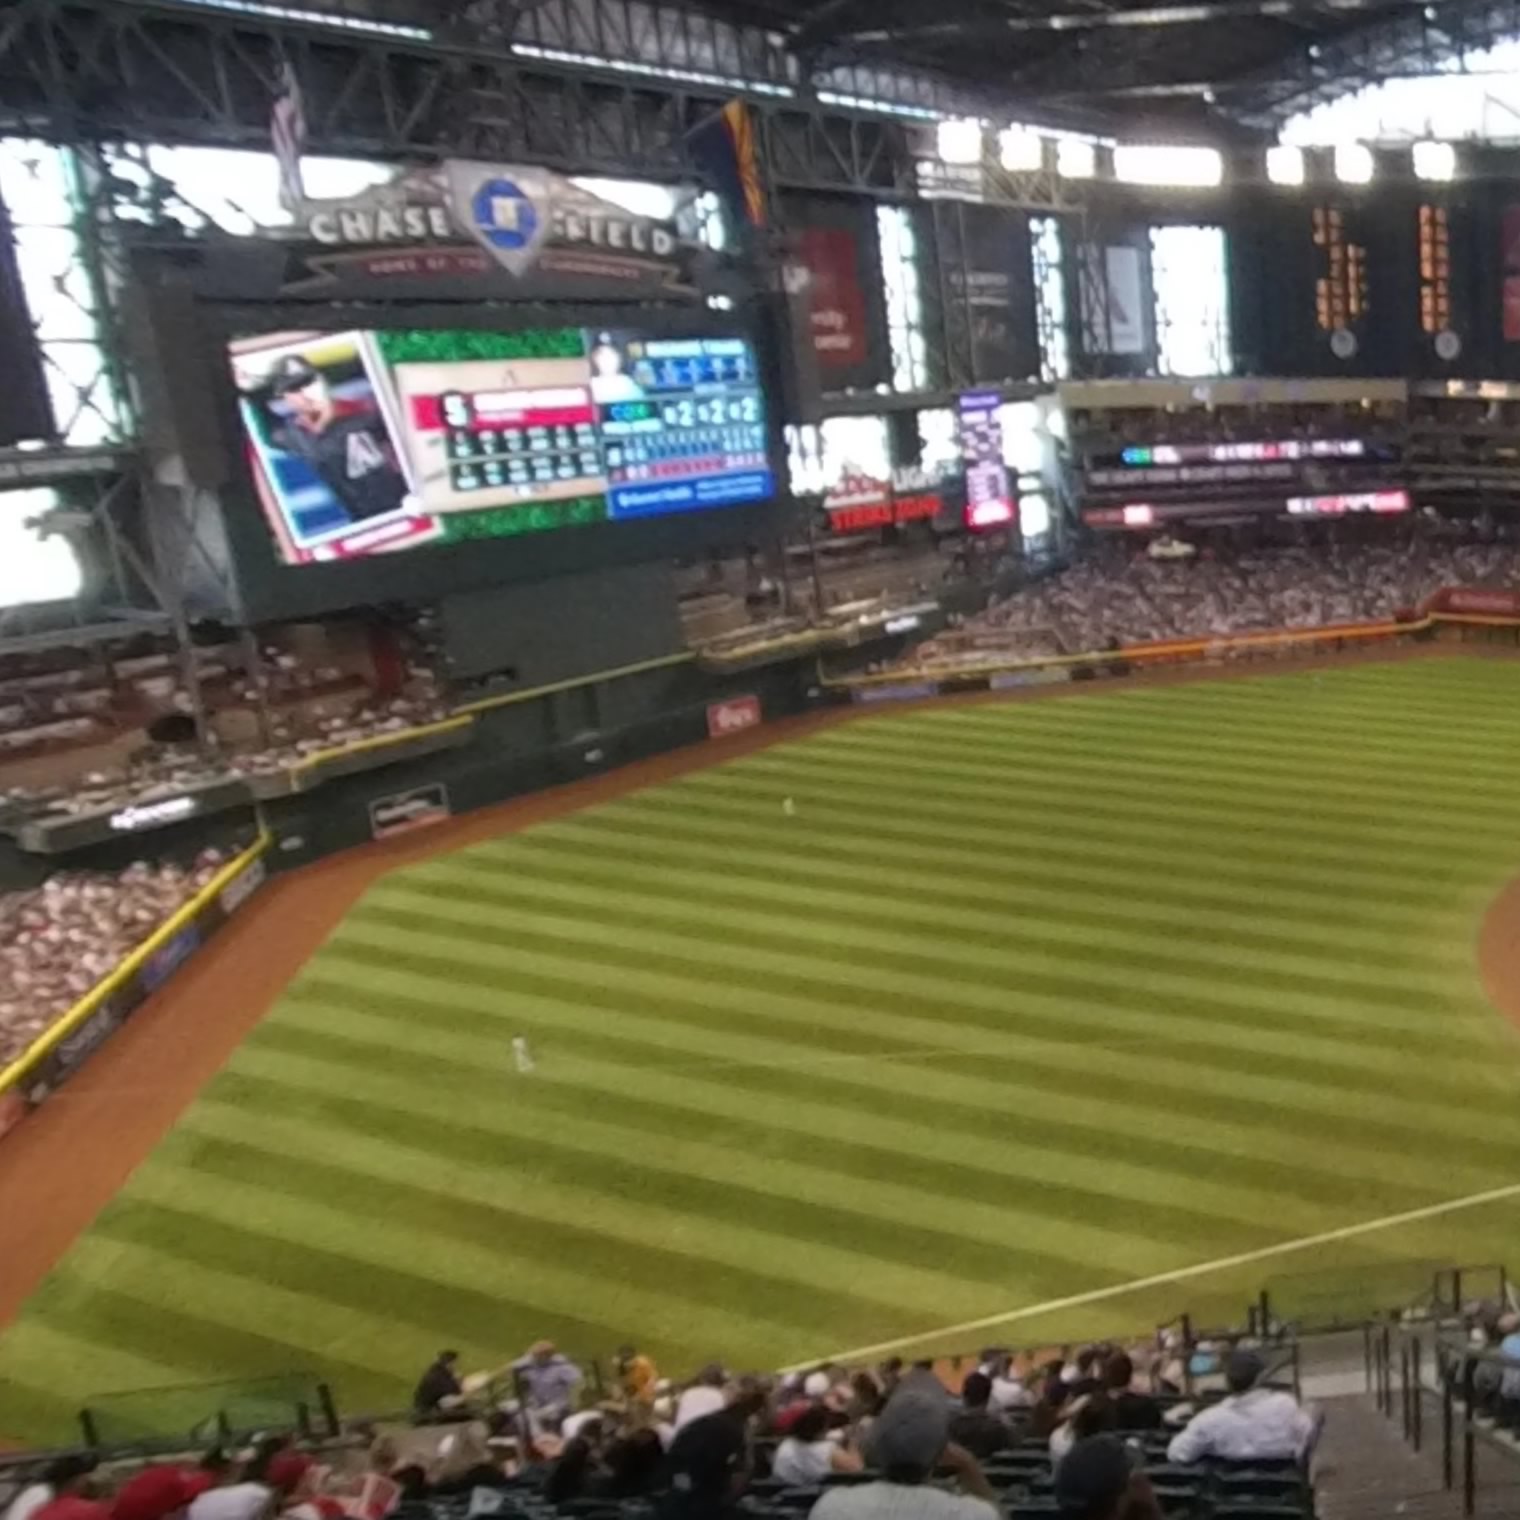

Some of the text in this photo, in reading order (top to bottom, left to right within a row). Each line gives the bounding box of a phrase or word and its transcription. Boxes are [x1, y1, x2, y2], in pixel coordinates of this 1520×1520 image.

[308, 207, 673, 255] CHASE FIELD
[678, 400, 693, 426] 2
[710, 399, 724, 424] 2
[742, 396, 756, 421] 2
